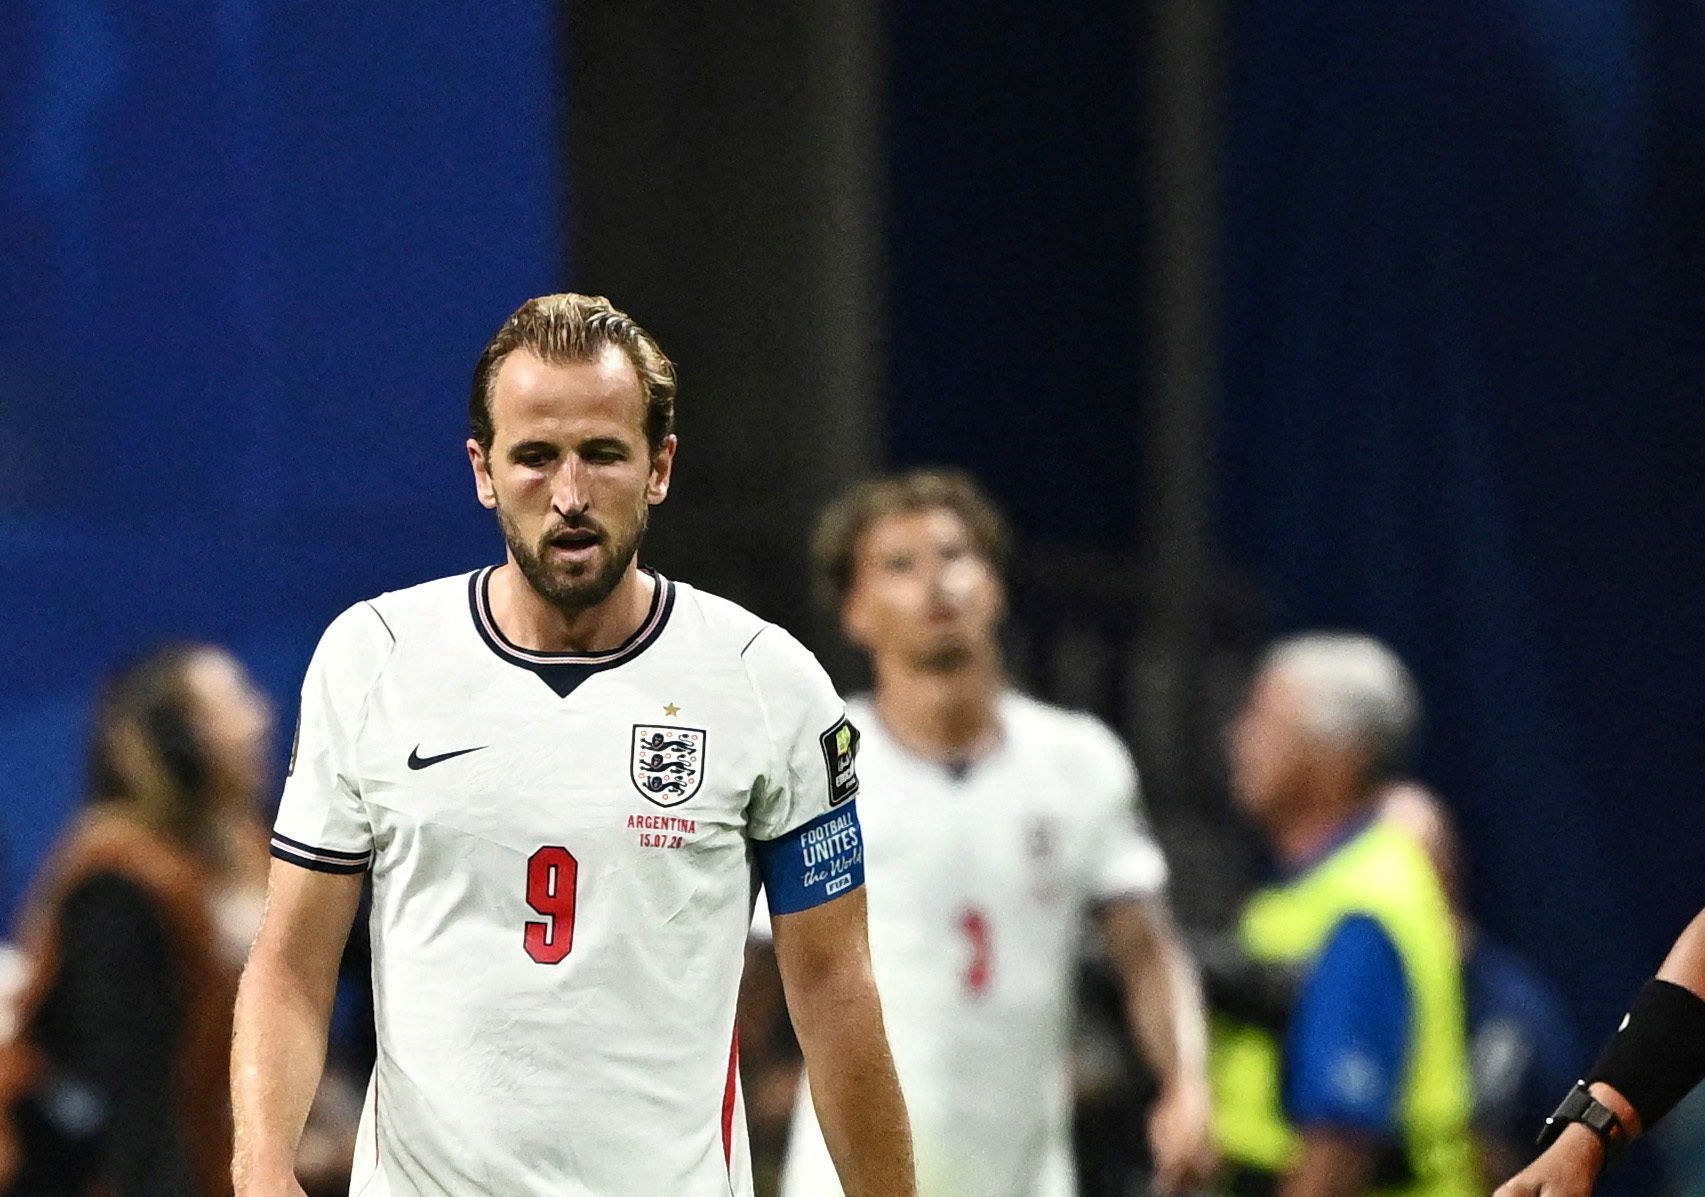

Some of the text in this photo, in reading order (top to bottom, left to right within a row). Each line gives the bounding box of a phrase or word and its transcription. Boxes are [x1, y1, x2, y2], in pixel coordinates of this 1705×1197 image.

[627, 815, 695, 833] ARGENTINA
[800, 812, 853, 848] FOOTBALL
[801, 846, 862, 887] the World
[803, 826, 858, 867] UNITES
[524, 846, 579, 965] 9
